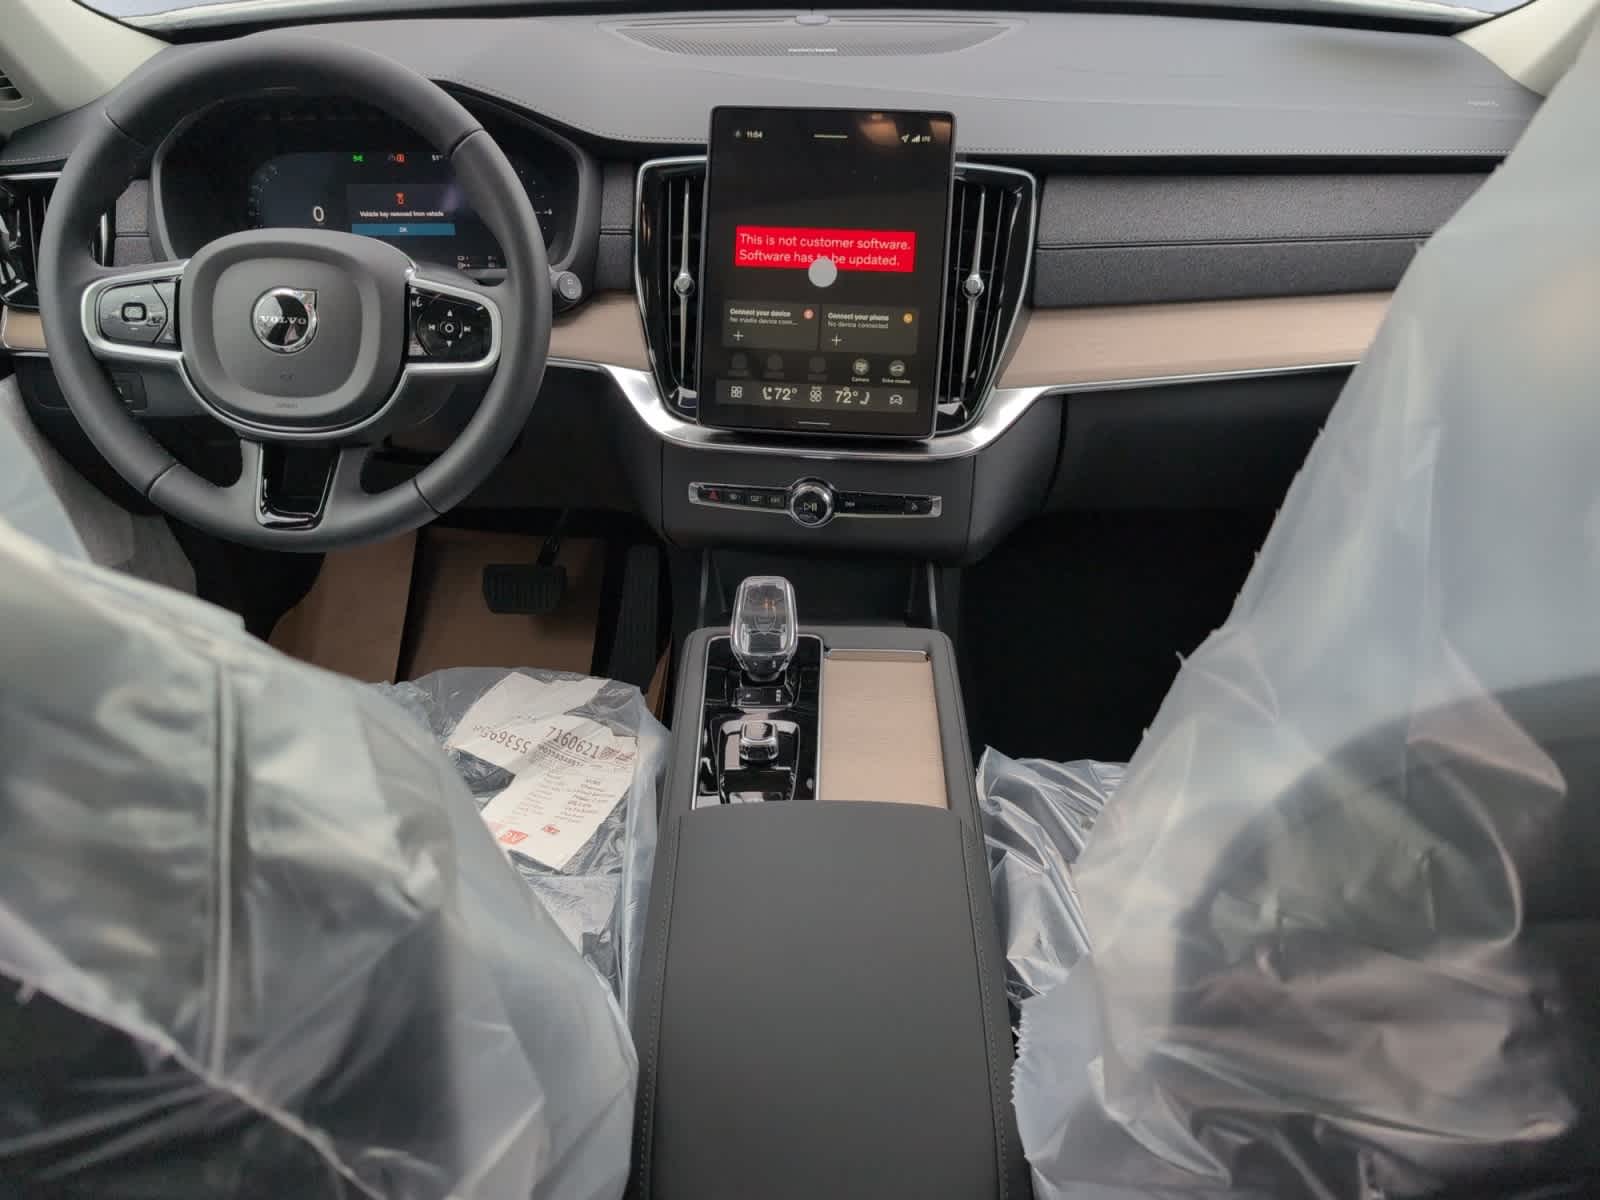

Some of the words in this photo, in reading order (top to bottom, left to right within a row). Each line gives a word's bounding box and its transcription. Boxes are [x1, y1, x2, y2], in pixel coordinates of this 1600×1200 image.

[313, 206, 325, 222] 0
[739, 233, 762, 245] This
[766, 235, 775, 246] is
[779, 236, 797, 247] not
[800, 237, 853, 249] customer
[857, 238, 911, 250] software.
[739, 249, 790, 262] Software
[794, 251, 814, 263] has
[831, 252, 846, 264] be
[849, 254, 900, 268] updated.
[730, 307, 755, 315] Connect
[828, 312, 853, 320] Connect
[259, 315, 307, 325] VOLVO
[774, 387, 798, 401] 72°
[835, 389, 859, 404] 72°
[545, 726, 600, 759] 7160621
